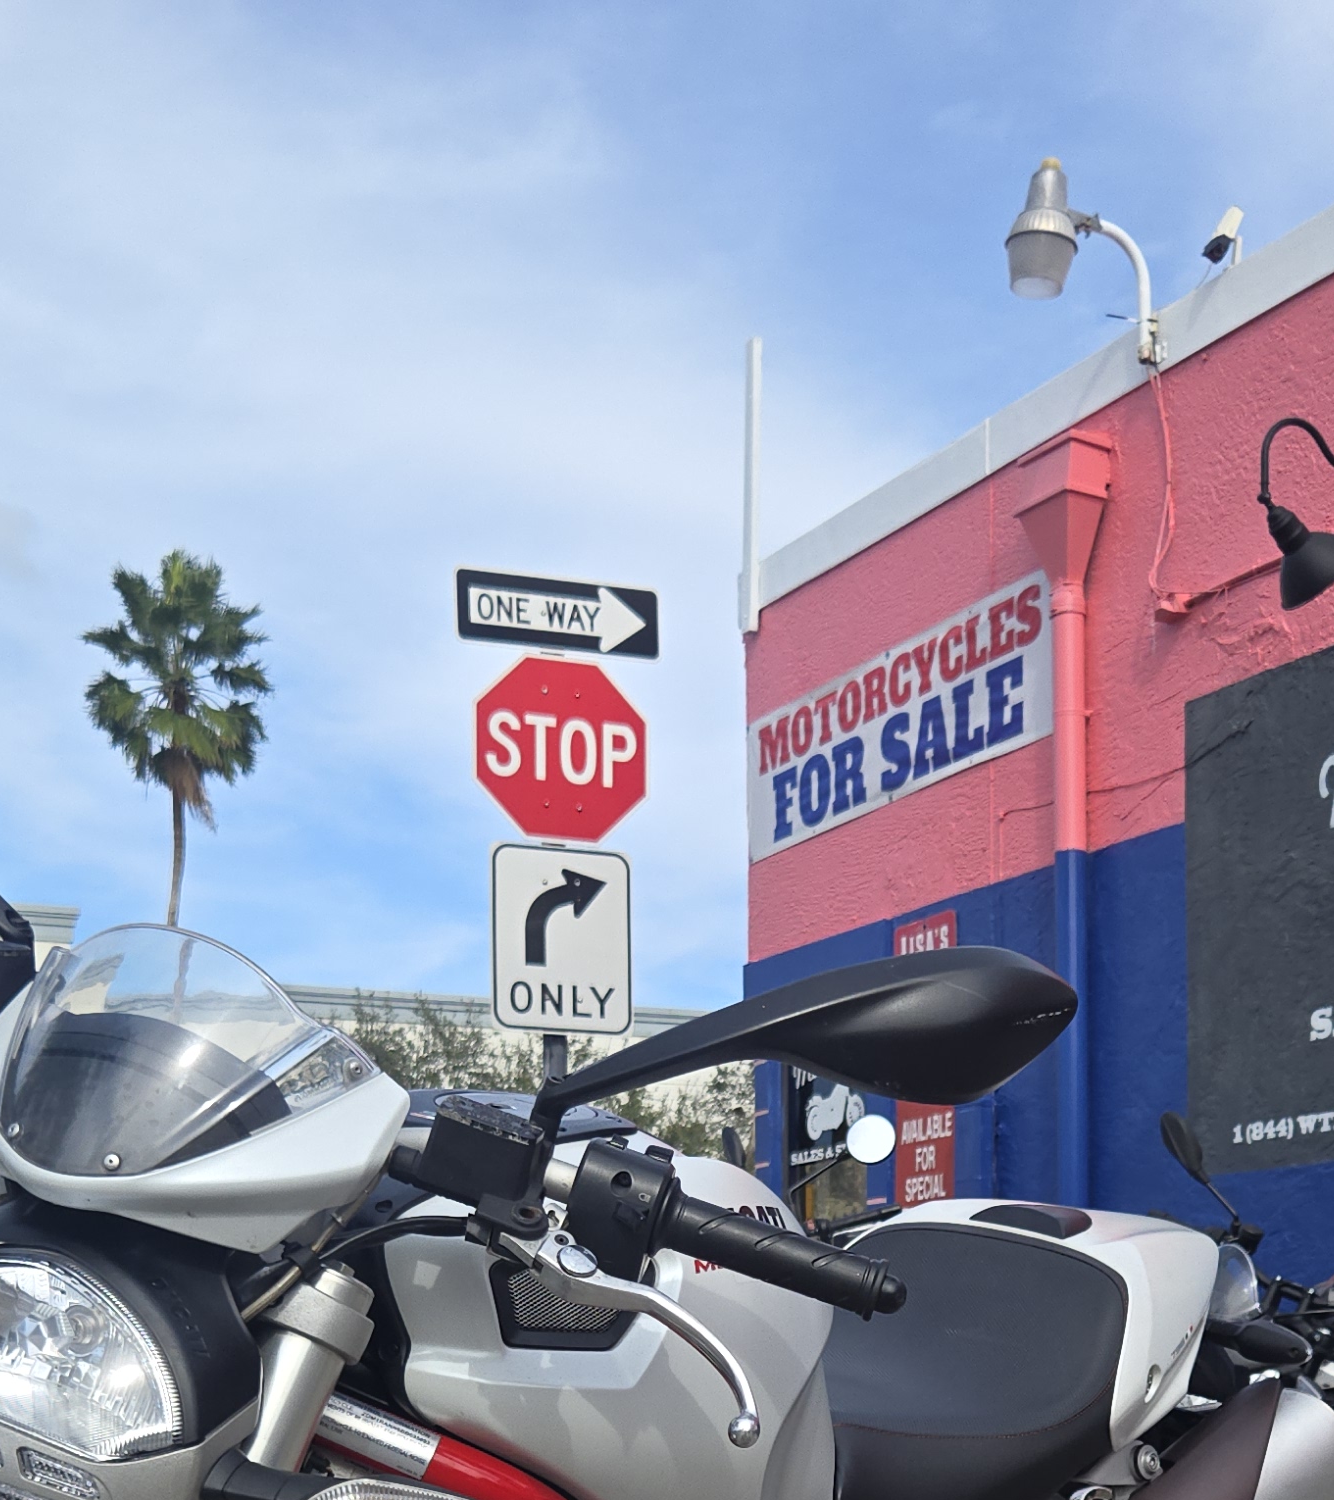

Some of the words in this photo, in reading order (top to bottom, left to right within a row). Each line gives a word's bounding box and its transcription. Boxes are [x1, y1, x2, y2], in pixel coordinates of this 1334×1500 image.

[477, 594, 530, 625] ONE
[546, 600, 600, 633] WAY
[759, 584, 1041, 776] MOTORCYCLES
[485, 711, 637, 787] STOP
[773, 736, 866, 843] FOR
[880, 655, 1024, 792] SALE
[510, 981, 615, 1019] ONLY
[901, 1111, 953, 1145] AVAILABLE
[1246, 1117, 1294, 1144] (844)
[791, 1148, 823, 1166] SALES
[915, 1146, 935, 1172] FOR
[905, 1174, 946, 1202] SPECIAL
